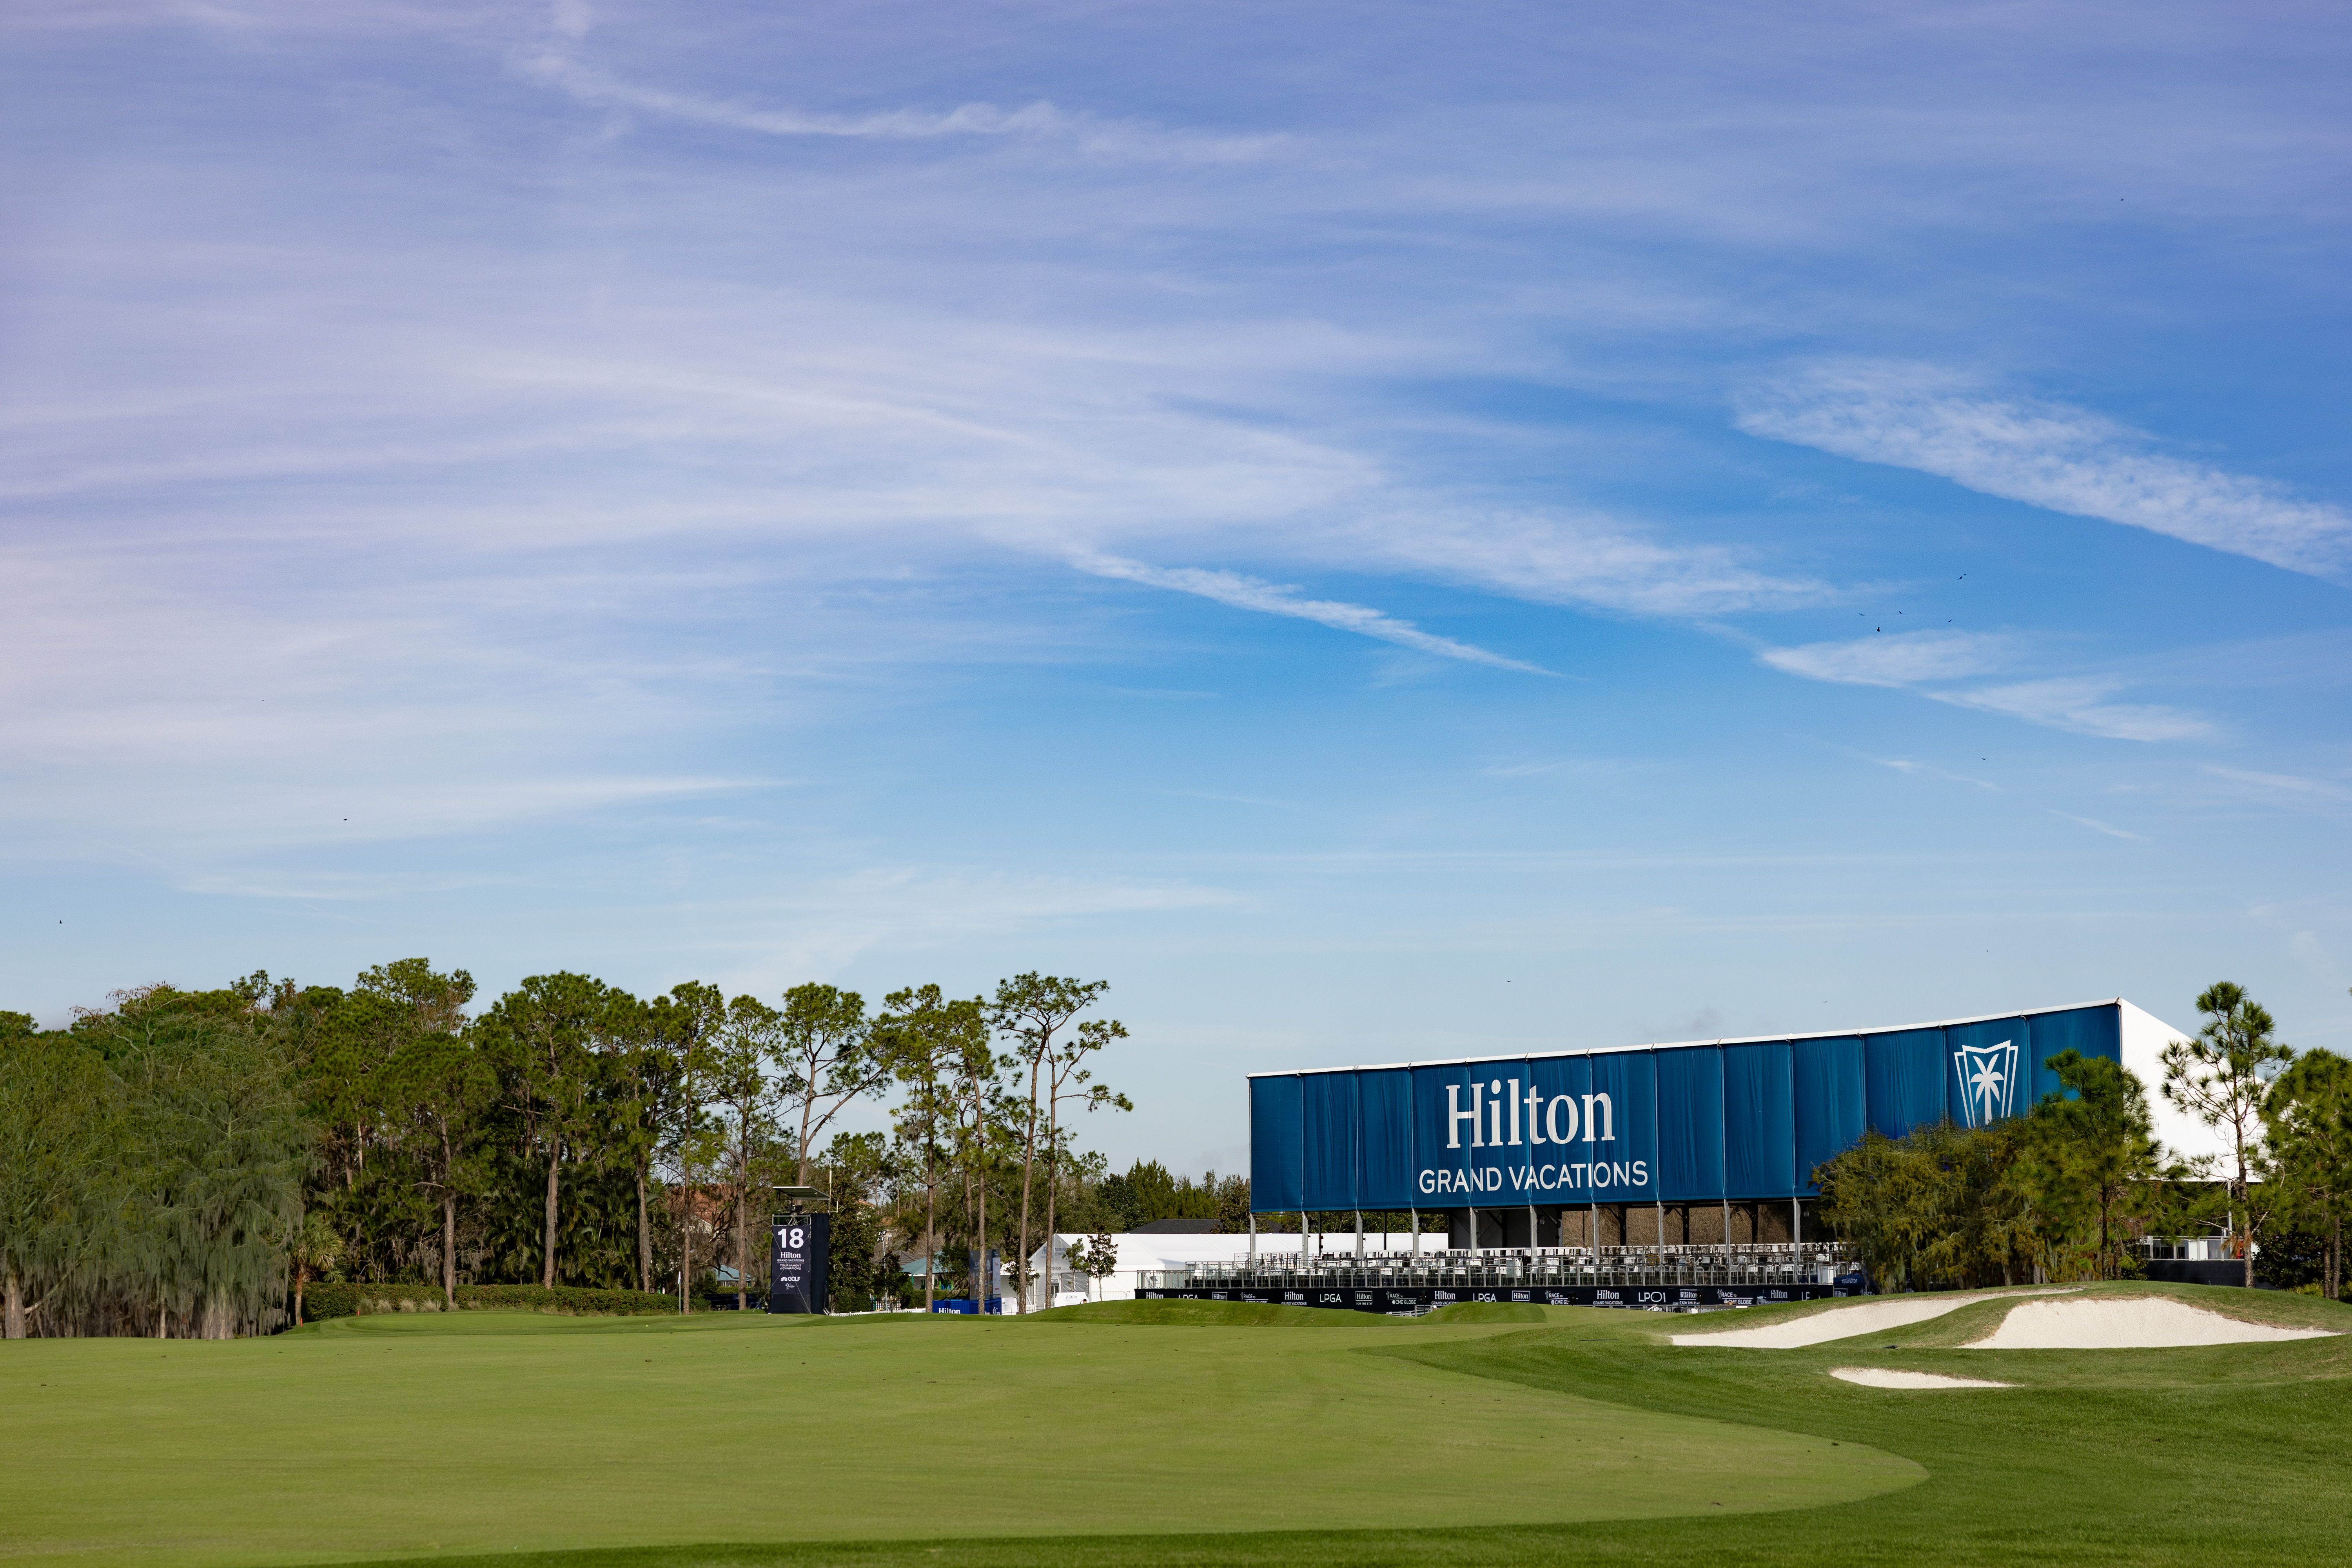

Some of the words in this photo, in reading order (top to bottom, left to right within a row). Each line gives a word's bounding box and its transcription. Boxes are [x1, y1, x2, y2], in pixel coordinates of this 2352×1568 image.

[1446, 1078, 1615, 1148] Hilton
[1419, 1167, 1502, 1194] GRAND
[1508, 1161, 1648, 1190] VACATIONS
[778, 1228, 804, 1248] 18
[1285, 1291, 1303, 1300] Hilton
[1320, 1294, 1341, 1302] LPGA
[1434, 1290, 1455, 1299] Hilton
[1473, 1293, 1496, 1302] LPGA
[1597, 1290, 1619, 1299] Hilton
